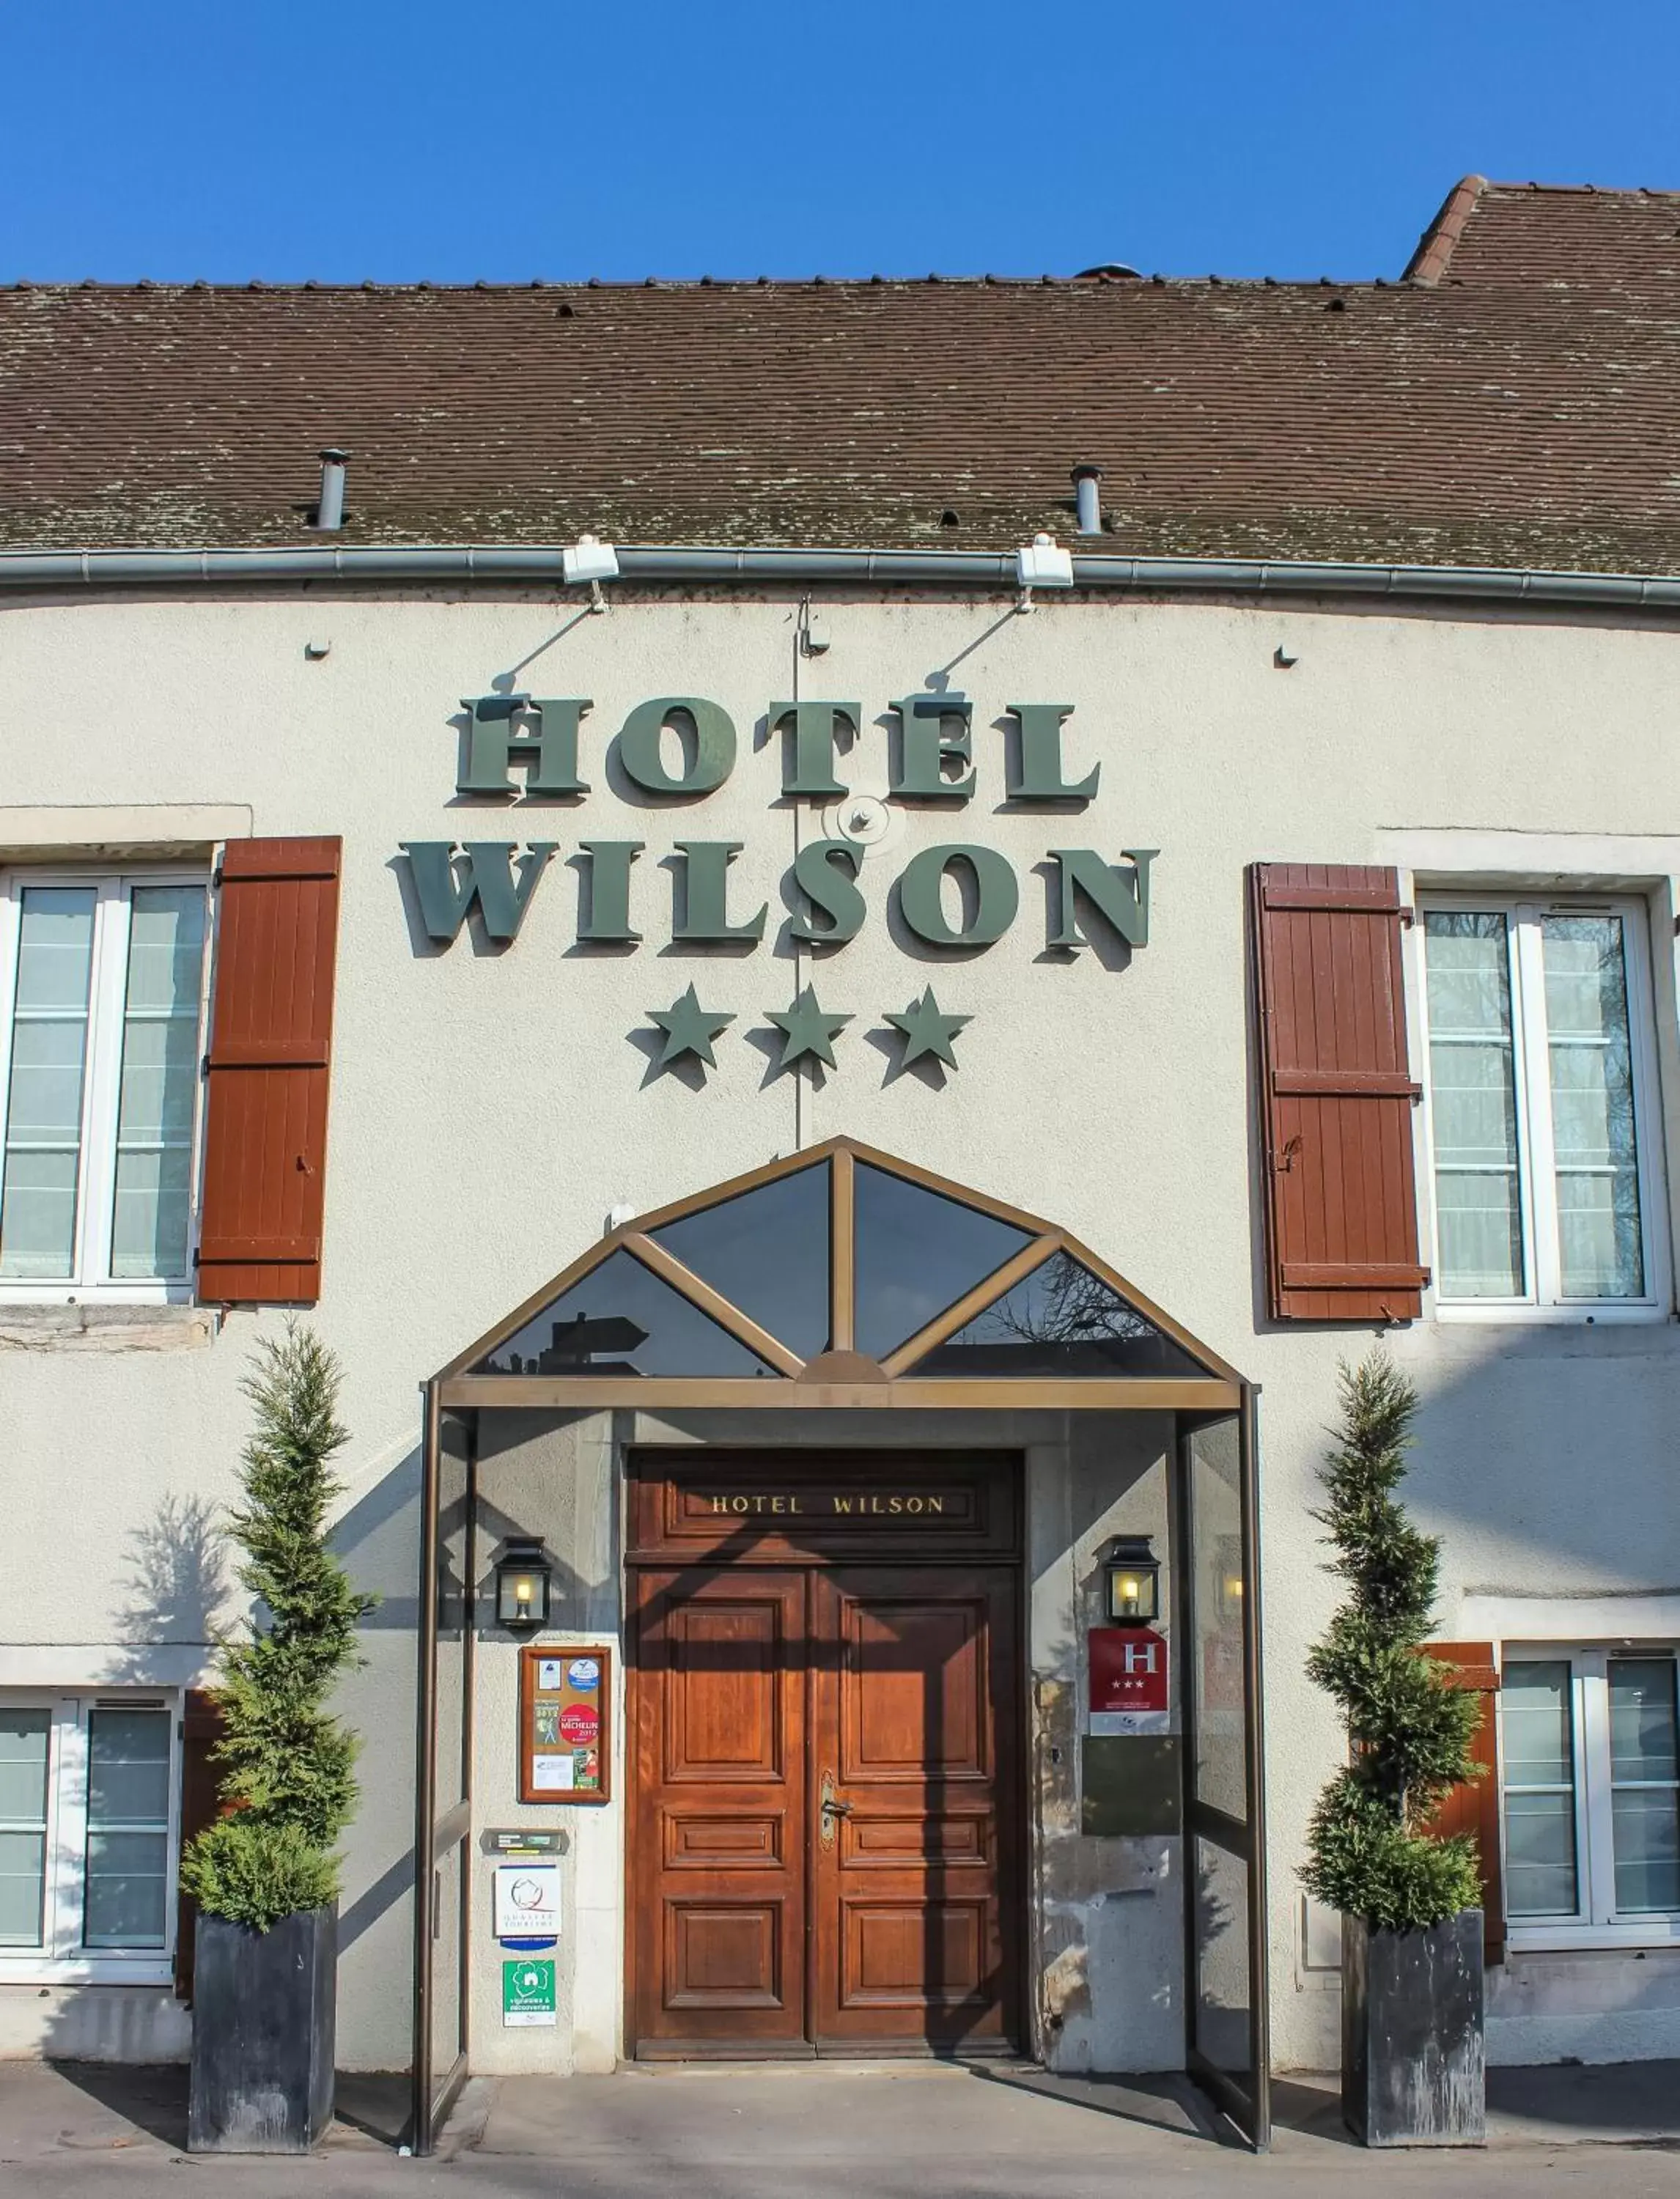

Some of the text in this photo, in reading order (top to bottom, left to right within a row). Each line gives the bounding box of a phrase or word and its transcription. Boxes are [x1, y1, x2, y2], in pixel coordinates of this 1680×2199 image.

[455, 696, 1101, 800] HOTEL
[398, 839, 1161, 949] WILSON
[712, 1495, 943, 1514] HOTEL WILSON
[1124, 1643, 1159, 1673] H
[561, 1721, 599, 1730] MICHELIN
